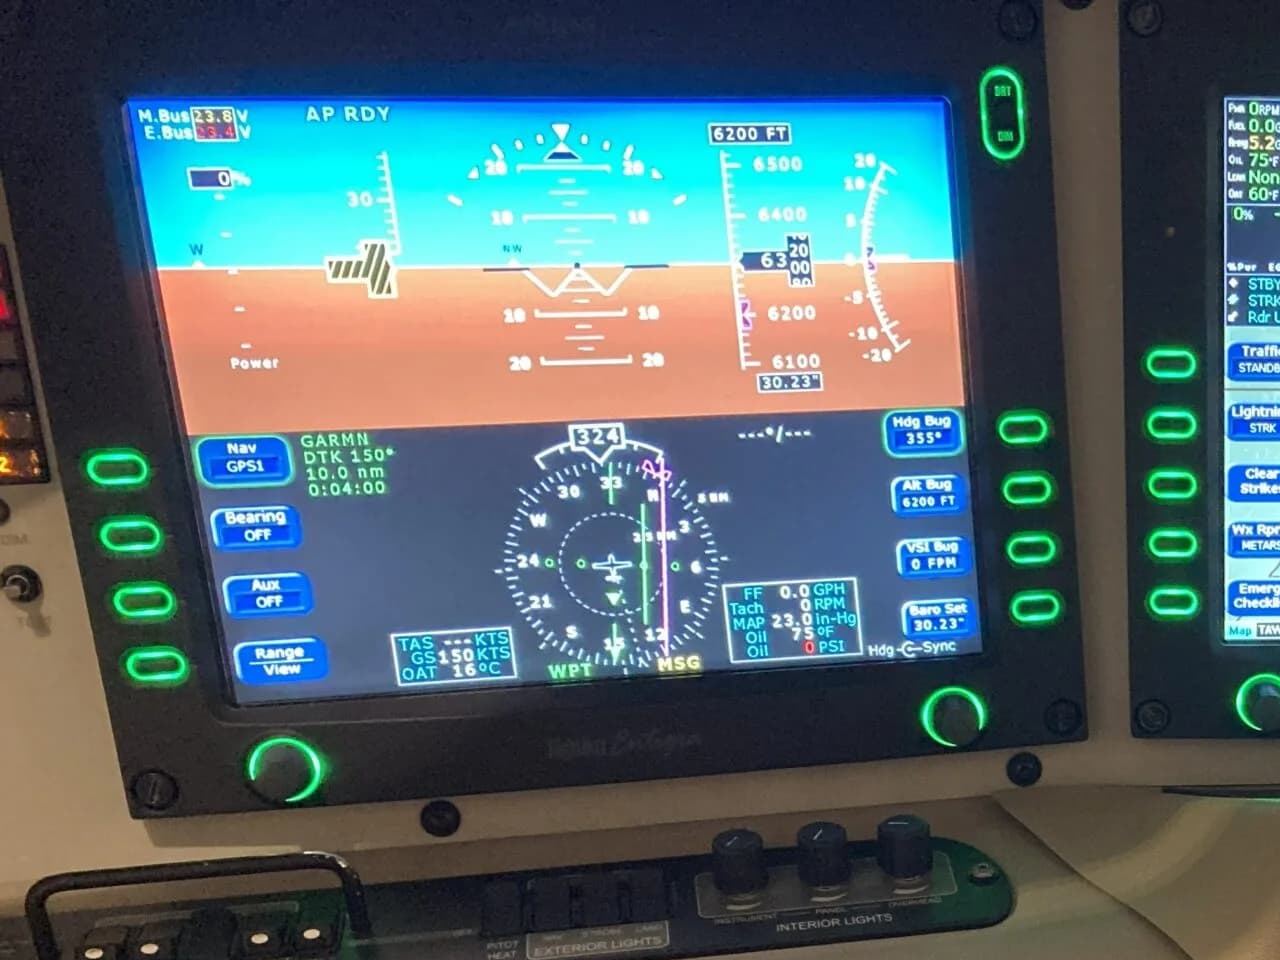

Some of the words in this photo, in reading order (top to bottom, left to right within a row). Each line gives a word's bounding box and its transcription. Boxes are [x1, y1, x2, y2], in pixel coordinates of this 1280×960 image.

[306, 107, 334, 121] AP
[345, 107, 390, 122] RDY
[714, 127, 758, 141] 6200
[766, 127, 786, 140] FT
[753, 157, 802, 171] 6500
[758, 207, 807, 222] 6400
[768, 306, 816, 321] 6200
[1249, 311, 1272, 323] Rdr
[230, 357, 279, 370] Power
[772, 355, 820, 370] 6100
[763, 375, 819, 389] 30.23"
[893, 415, 920, 429] Hdg
[924, 415, 951, 428] Bug
[1249, 423, 1276, 433] STRK
[301, 433, 368, 447] GARMN
[577, 428, 619, 444] 324
[227, 443, 256, 454] Nav
[305, 451, 343, 464] DTK
[352, 449, 395, 463] 150°
[227, 460, 265, 473] GPS1
[1245, 468, 1279, 479] Clear
[307, 468, 348, 481] 10.0
[358, 467, 384, 478] nm
[309, 482, 385, 496] 0:04:00
[903, 479, 922, 491] Alt
[926, 479, 951, 492] Bug
[903, 496, 935, 507] 6200
[941, 496, 955, 505] FT
[225, 511, 286, 526] Bearing
[244, 529, 271, 542] OFF
[252, 579, 280, 591] Aux
[744, 588, 762, 599] FF
[780, 585, 809, 599] 0.0
[814, 583, 844, 596] GPH
[256, 596, 282, 608] OFF
[734, 617, 764, 630] MAP
[772, 613, 812, 628] 23.0
[816, 612, 856, 626] in-Hg
[1229, 626, 1252, 637] Map
[255, 646, 304, 660] Range
[412, 651, 435, 665] GS
[439, 649, 473, 665] 150
[477, 647, 510, 660] KTS
[264, 664, 301, 676] View
[658, 656, 700, 671] MSG
[549, 664, 592, 679] WPT
[776, 918, 841, 933] INTERIOR
[844, 913, 894, 928] LIGHTS
[534, 942, 608, 957] EXTERIOR
[611, 935, 663, 950] LIGHTS
